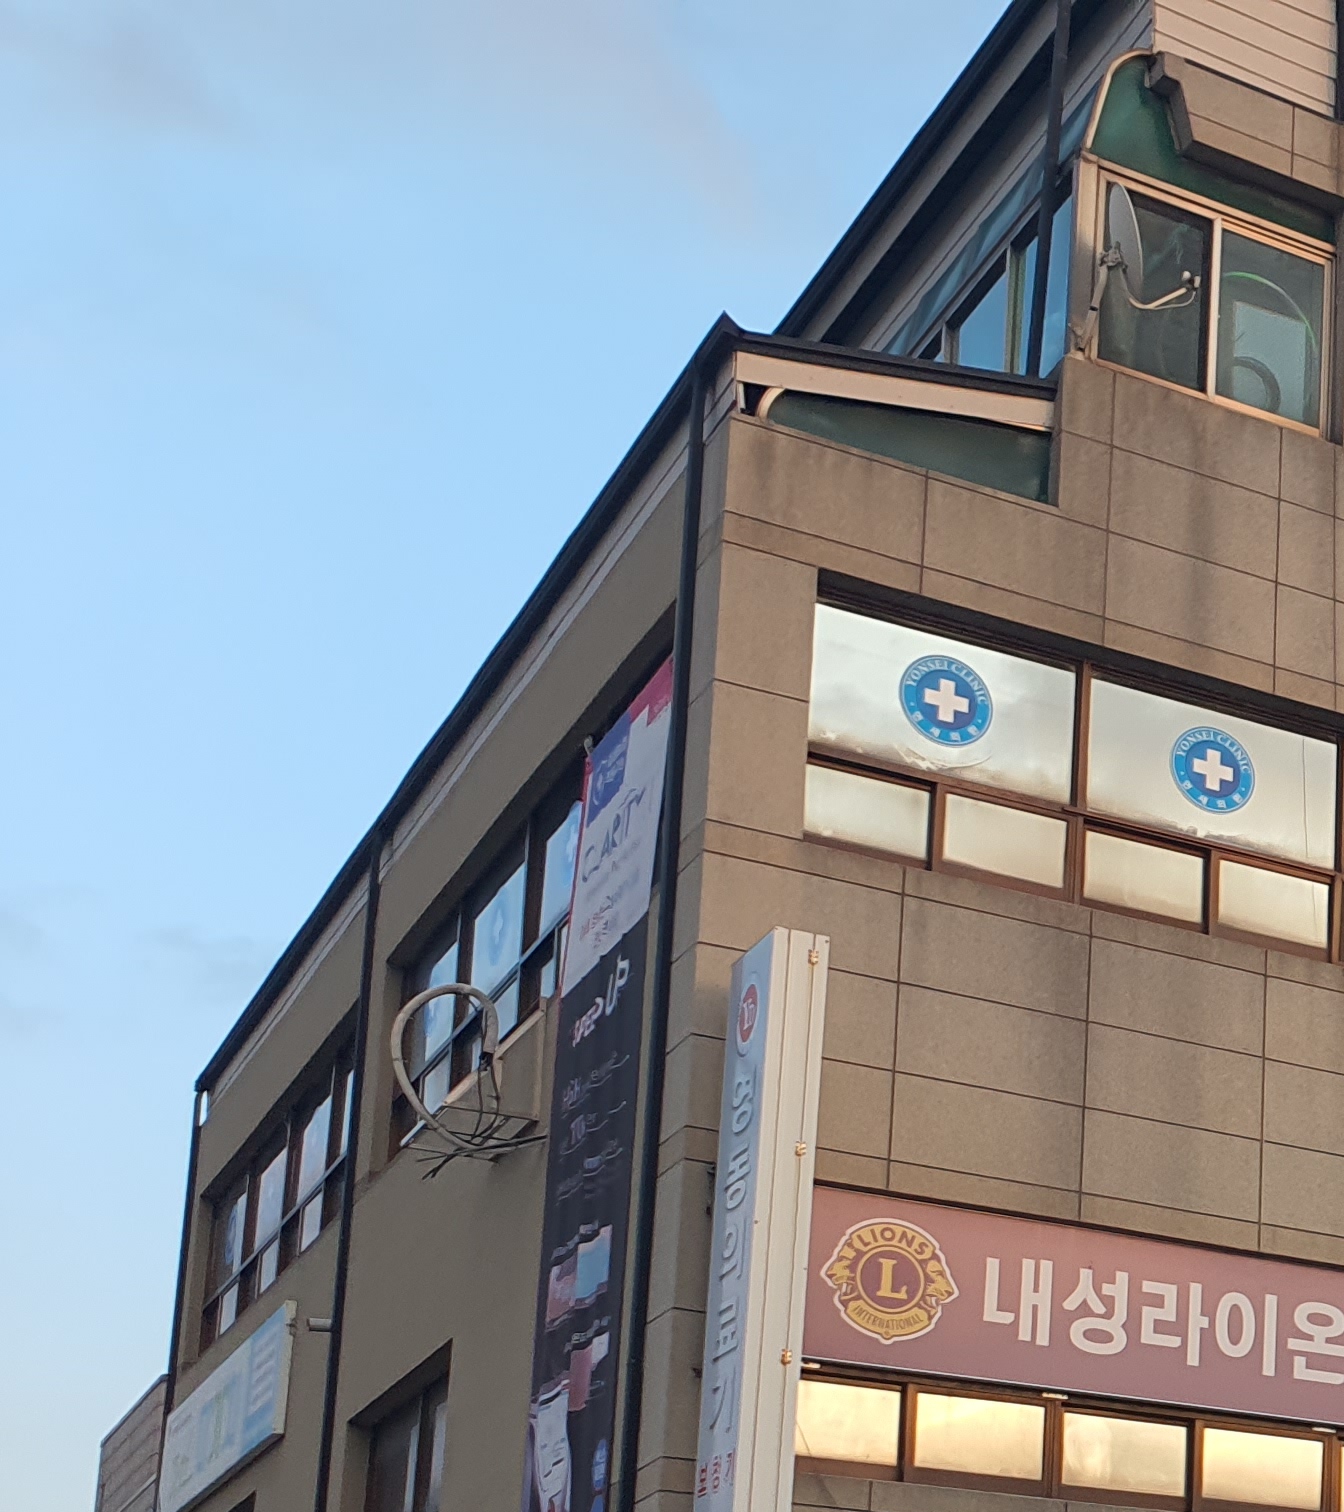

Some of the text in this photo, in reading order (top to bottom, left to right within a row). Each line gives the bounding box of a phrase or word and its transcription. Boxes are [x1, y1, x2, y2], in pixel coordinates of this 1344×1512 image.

[905, 658, 988, 705] YONSEI CLINIC
[1176, 731, 1251, 773] YONSEI CLINIC
[856, 1226, 931, 1258] LIONS
[876, 1257, 908, 1300] L
[853, 1304, 924, 1331] INTERNATIONAL
